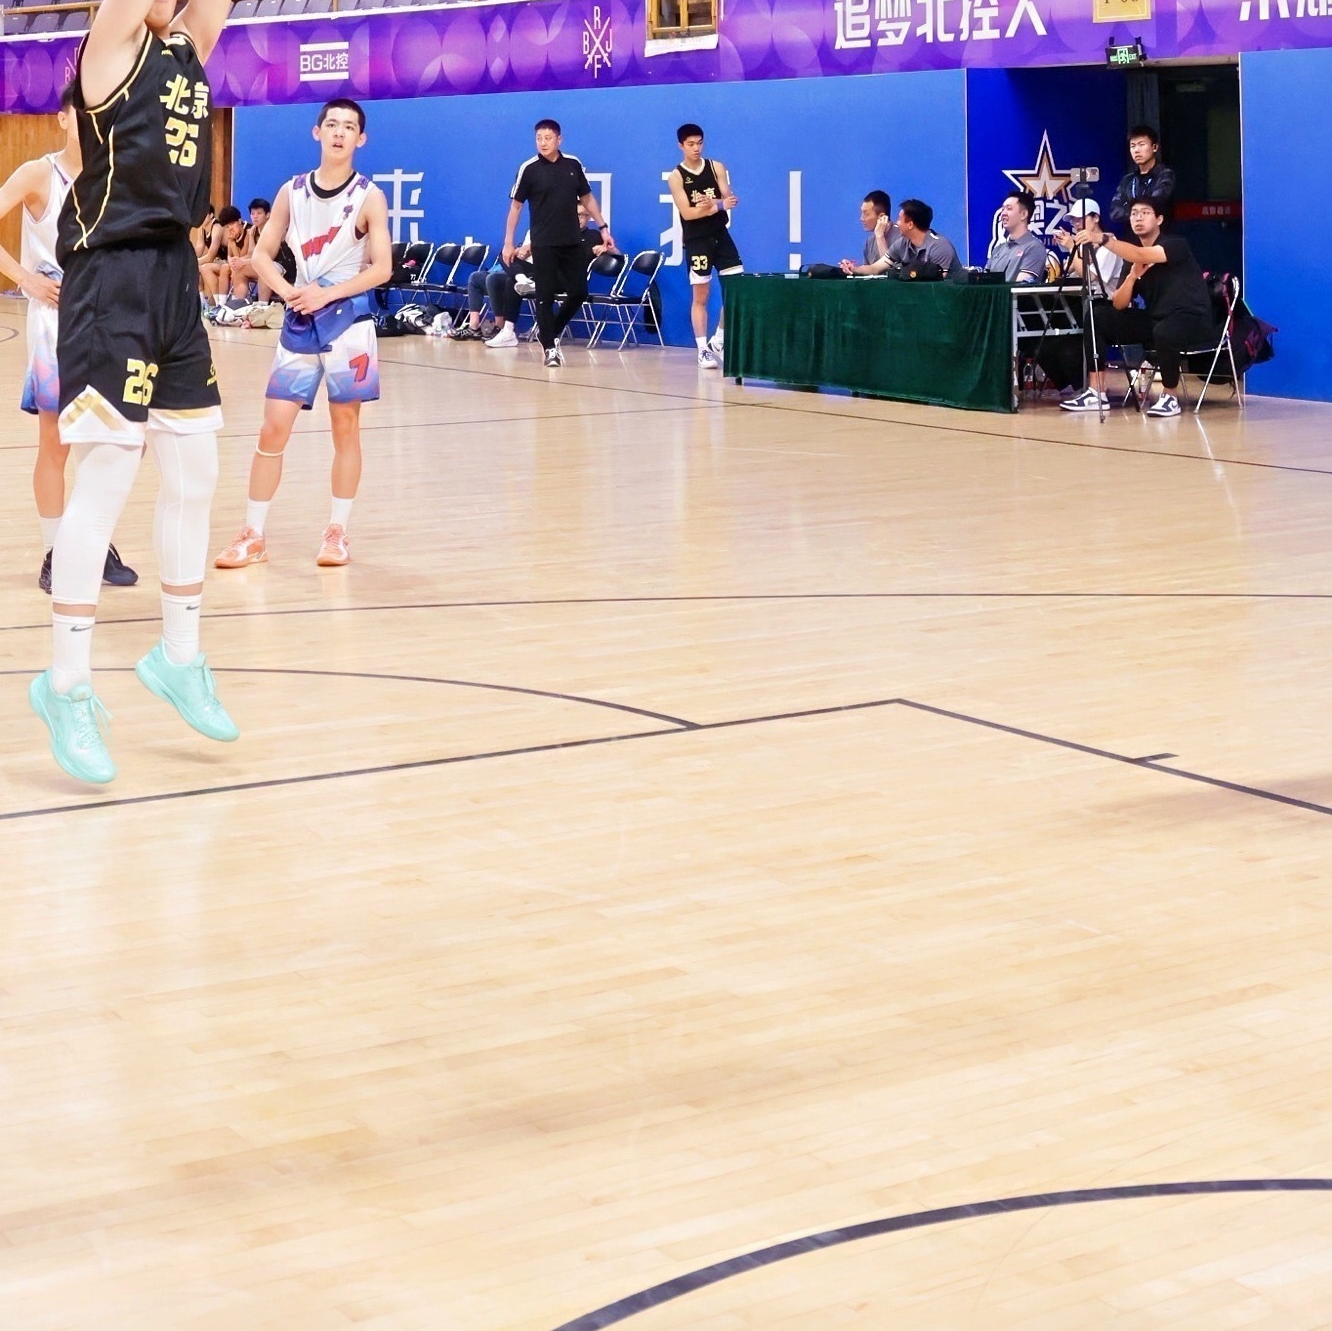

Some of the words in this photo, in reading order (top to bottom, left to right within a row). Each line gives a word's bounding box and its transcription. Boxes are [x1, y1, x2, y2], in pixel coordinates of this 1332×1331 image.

[299, 52, 349, 73] BG北控
[159, 73, 210, 120] 北京
[691, 255, 708, 271] 33
[123, 358, 159, 406] 26
[349, 352, 370, 383] 7
